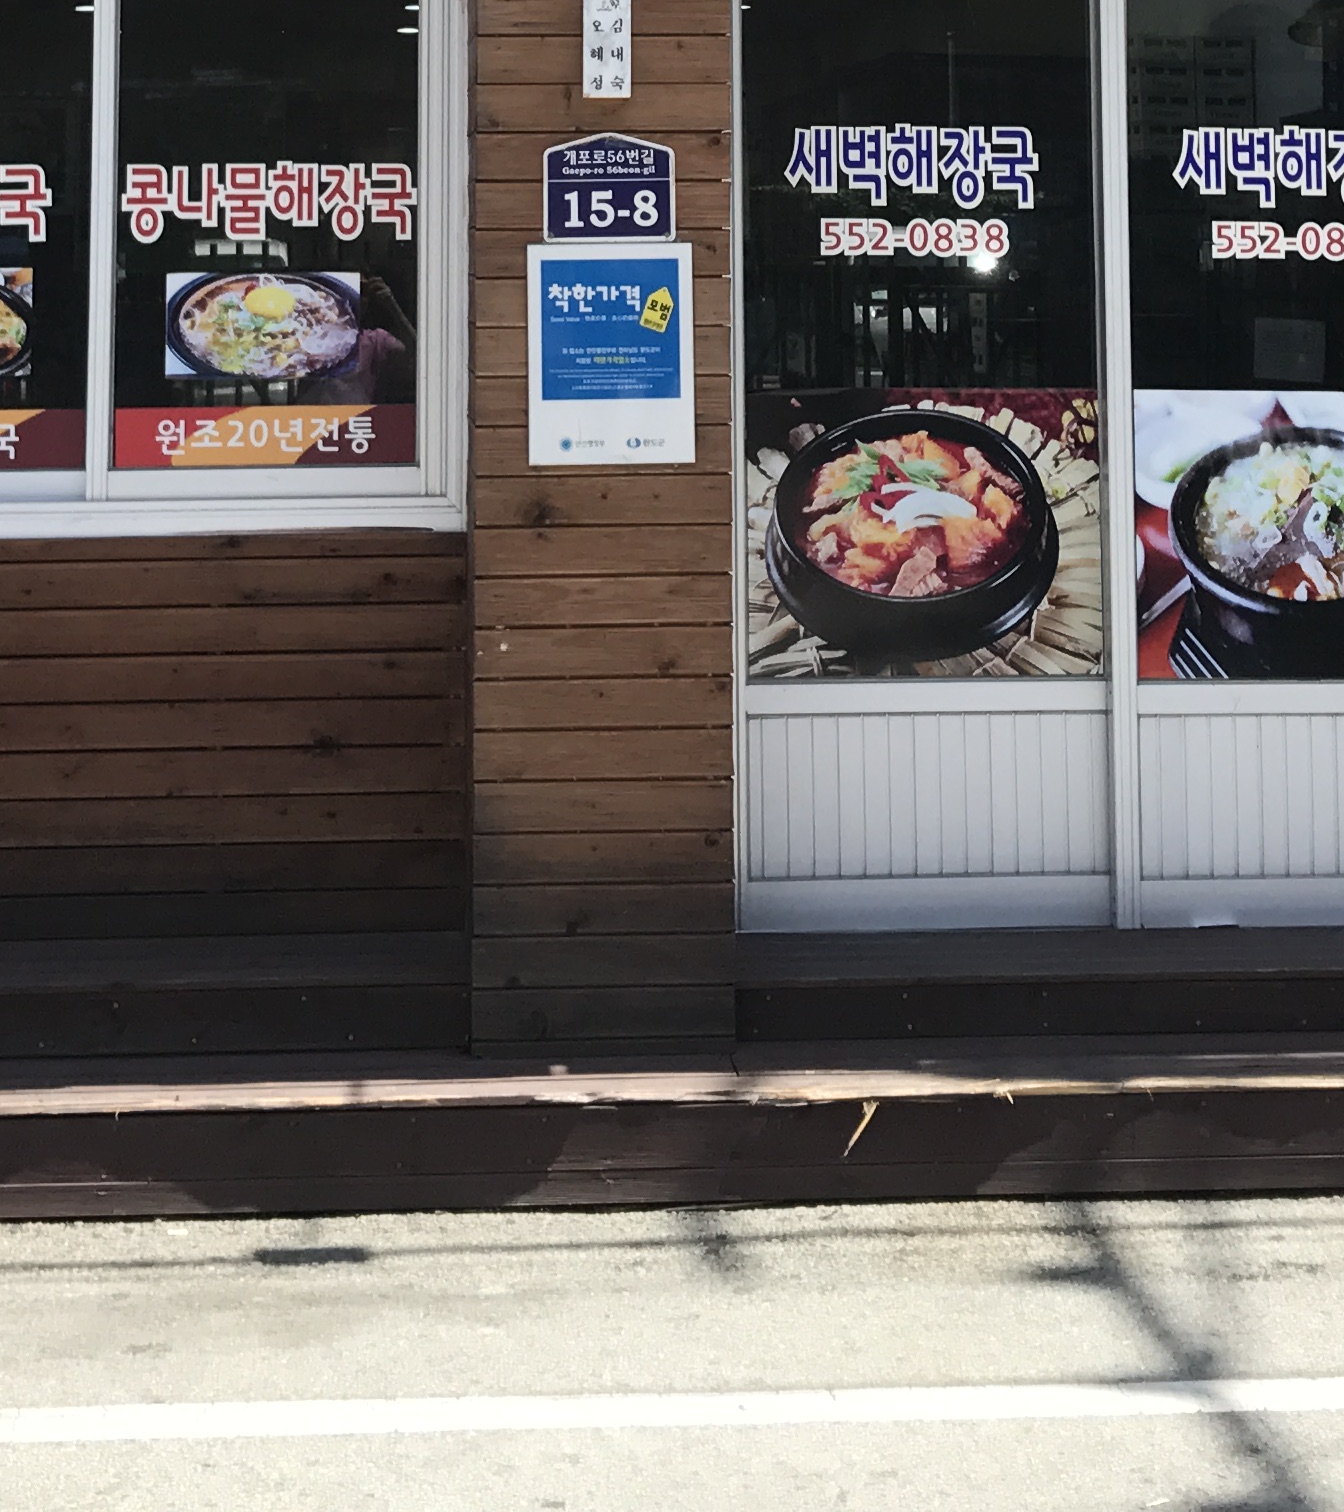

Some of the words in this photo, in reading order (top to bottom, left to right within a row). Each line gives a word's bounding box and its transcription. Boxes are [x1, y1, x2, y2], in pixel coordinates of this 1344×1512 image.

[563, 149, 654, 165] 개포로56번길
[785, 123, 1039, 209] 새벽해장국
[121, 160, 418, 243] 콩나물해장국
[564, 189, 659, 228] 15-8
[820, 217, 1009, 258] 552-0838
[548, 283, 640, 313] 착한가격
[647, 299, 672, 322] 모범
[155, 416, 376, 455] 원조20년전통
